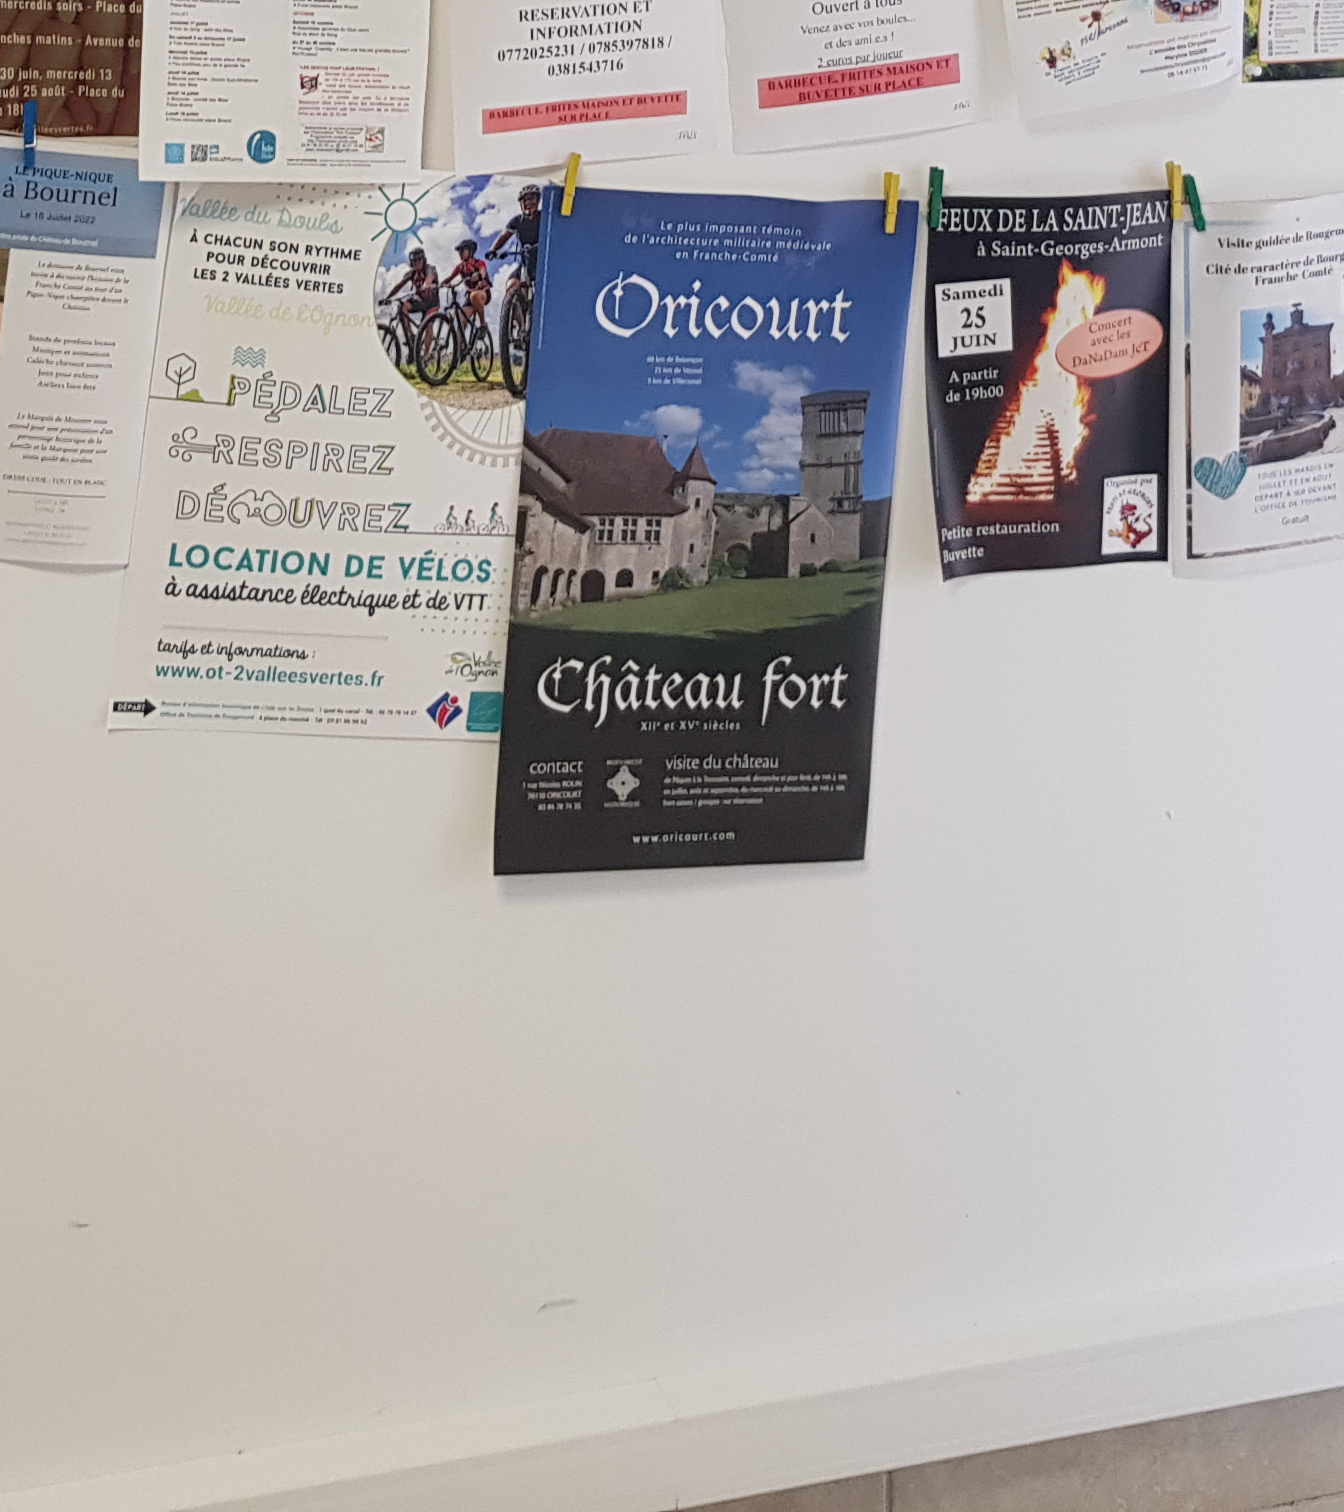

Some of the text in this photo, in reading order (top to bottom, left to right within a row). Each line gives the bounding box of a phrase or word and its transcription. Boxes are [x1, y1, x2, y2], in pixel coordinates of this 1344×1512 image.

[518, 0, 652, 24] RESERVATION ET
[529, 16, 644, 38] INFORMATION
[548, 59, 624, 77] 0381543716
[2, 180, 118, 207] à Bournel
[937, 201, 1167, 233] FEUX DE LA SAINT-JEAN
[977, 232, 1164, 260] à Saint-Georges-Armont
[941, 285, 1004, 302] Samedi
[595, 271, 852, 343] Oricourt
[960, 305, 986, 330] 25
[949, 332, 996, 352] JUIN
[228, 371, 394, 422] PÉDALEZ
[213, 433, 396, 475] RESPIREZ
[941, 519, 1059, 542] Petite restauration
[168, 542, 491, 583] LOCATION DE VÉLOS
[943, 545, 984, 563] Buvette
[155, 663, 385, 689] www.ot-2valleesvertes.fr
[537, 654, 848, 727] Château fort
[529, 758, 583, 775] contact
[665, 753, 779, 771] visite du château
[632, 830, 735, 845] www.oricourt.com
